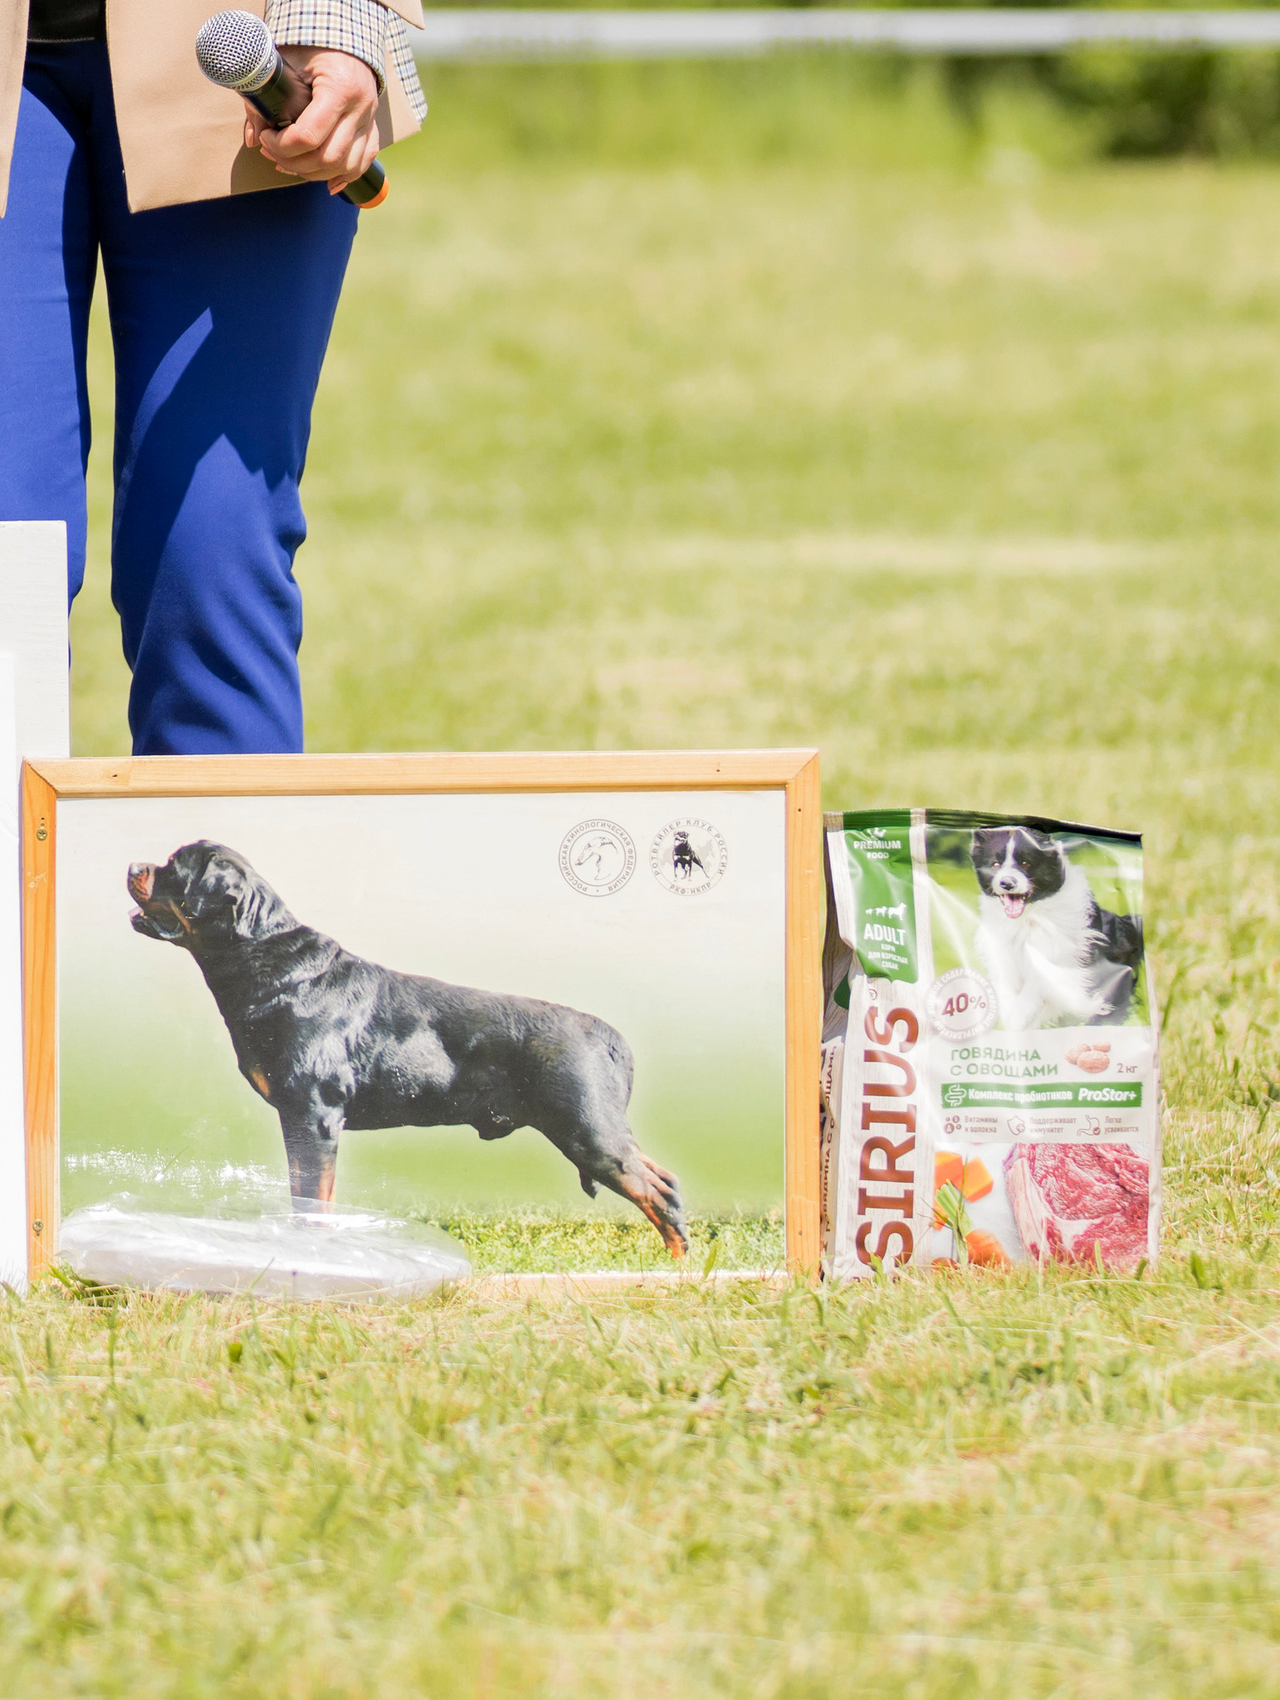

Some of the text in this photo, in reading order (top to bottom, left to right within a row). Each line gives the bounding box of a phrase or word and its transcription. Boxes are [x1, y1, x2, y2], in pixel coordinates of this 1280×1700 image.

[651, 819, 728, 876] РОТВЕЙЛЕР КЛУБ РОССИИ
[852, 839, 902, 850] PREMIUM
[561, 821, 634, 892] РОССИЙСКАЯ КИНОЛОГИЧЕСКАЯ ФЕДЕРАЦИЯ
[866, 851, 890, 859] FOOD
[863, 922, 907, 946] ADULT
[941, 992, 986, 1017] 40%
[950, 1047, 1042, 1062] ГОВЯДИНА
[950, 1063, 1058, 1078] С ОВОЩАМИ
[1116, 1062, 1138, 1074] 2 кг
[968, 1088, 1014, 1101] Комплекс
[1015, 1089, 1073, 1103] пробиотиков
[964, 1115, 998, 1124] Витамины
[855, 1005, 919, 1271] SIRIUS
